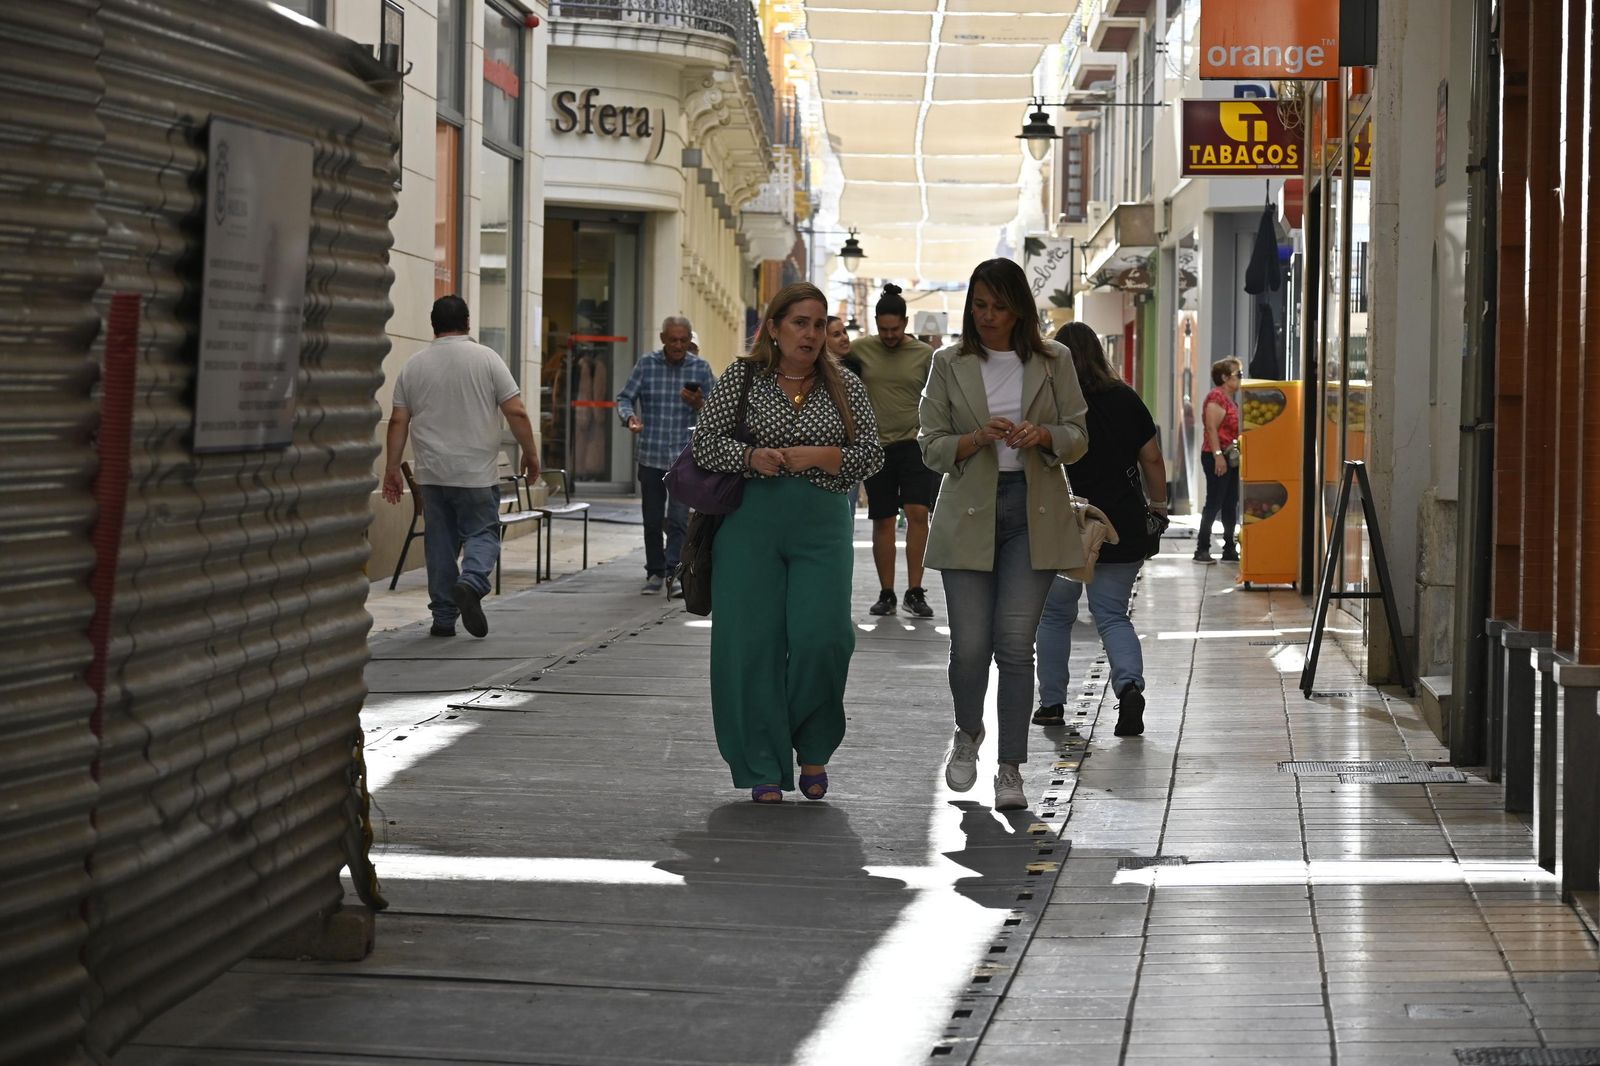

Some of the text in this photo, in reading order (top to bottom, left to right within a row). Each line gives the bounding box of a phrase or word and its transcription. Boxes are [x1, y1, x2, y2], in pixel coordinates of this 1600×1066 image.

[1207, 45, 1324, 73] orange
[553, 88, 652, 138] Sfera
[1189, 144, 1298, 164] TABACOS
